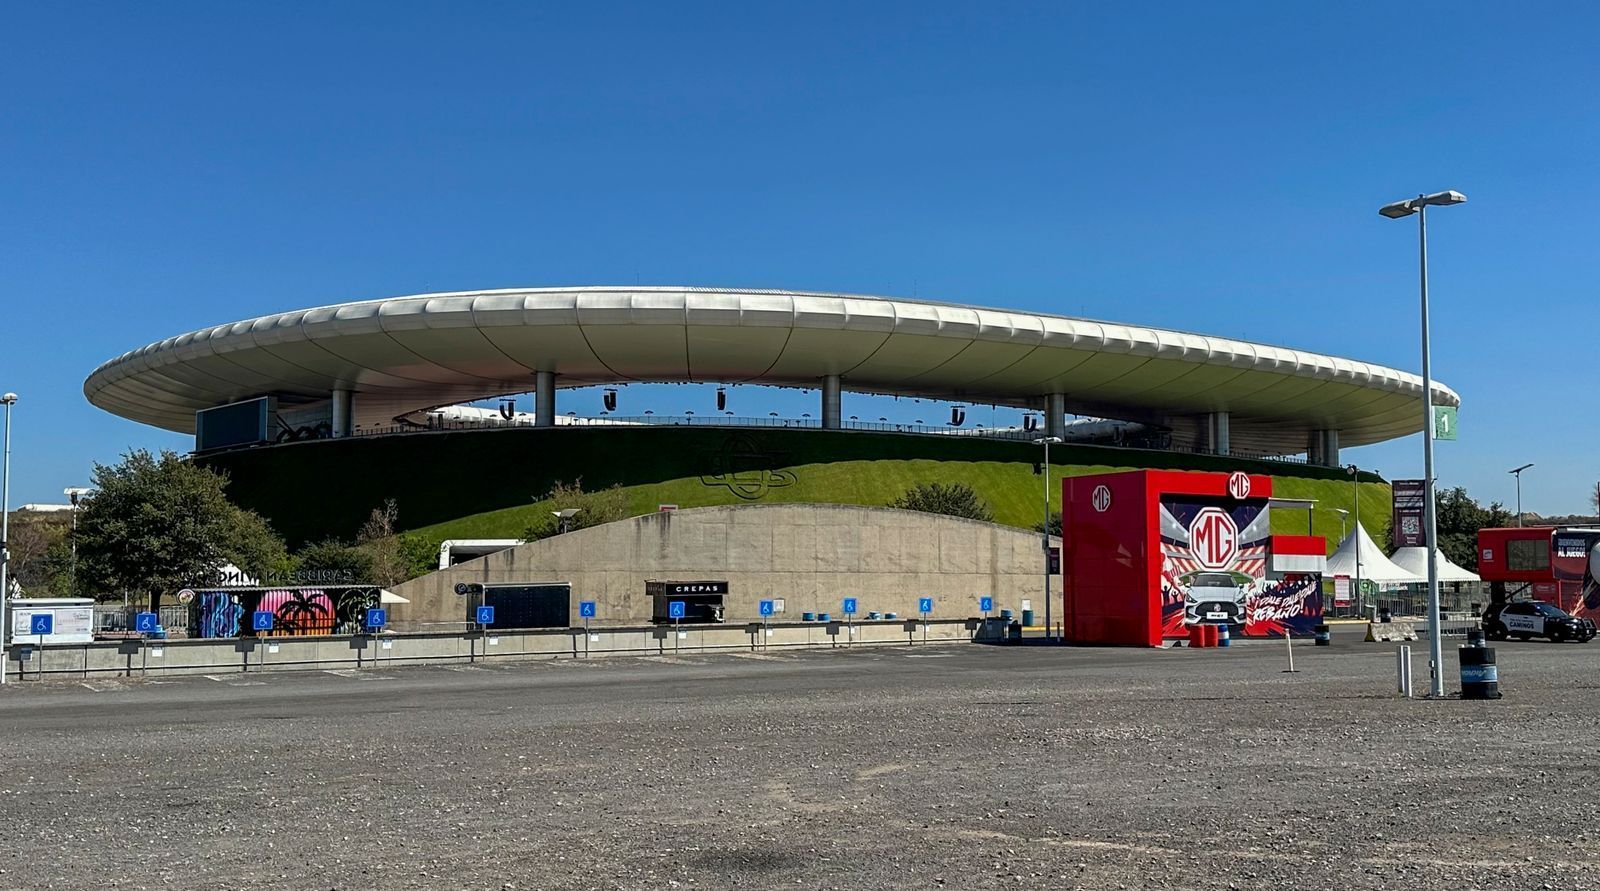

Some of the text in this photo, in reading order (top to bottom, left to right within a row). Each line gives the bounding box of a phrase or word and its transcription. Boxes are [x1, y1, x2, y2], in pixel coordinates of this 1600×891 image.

[1441, 414, 1449, 432] 1
[1230, 474, 1250, 498] MG
[1093, 486, 1111, 511] MG
[1195, 515, 1233, 565] MG
